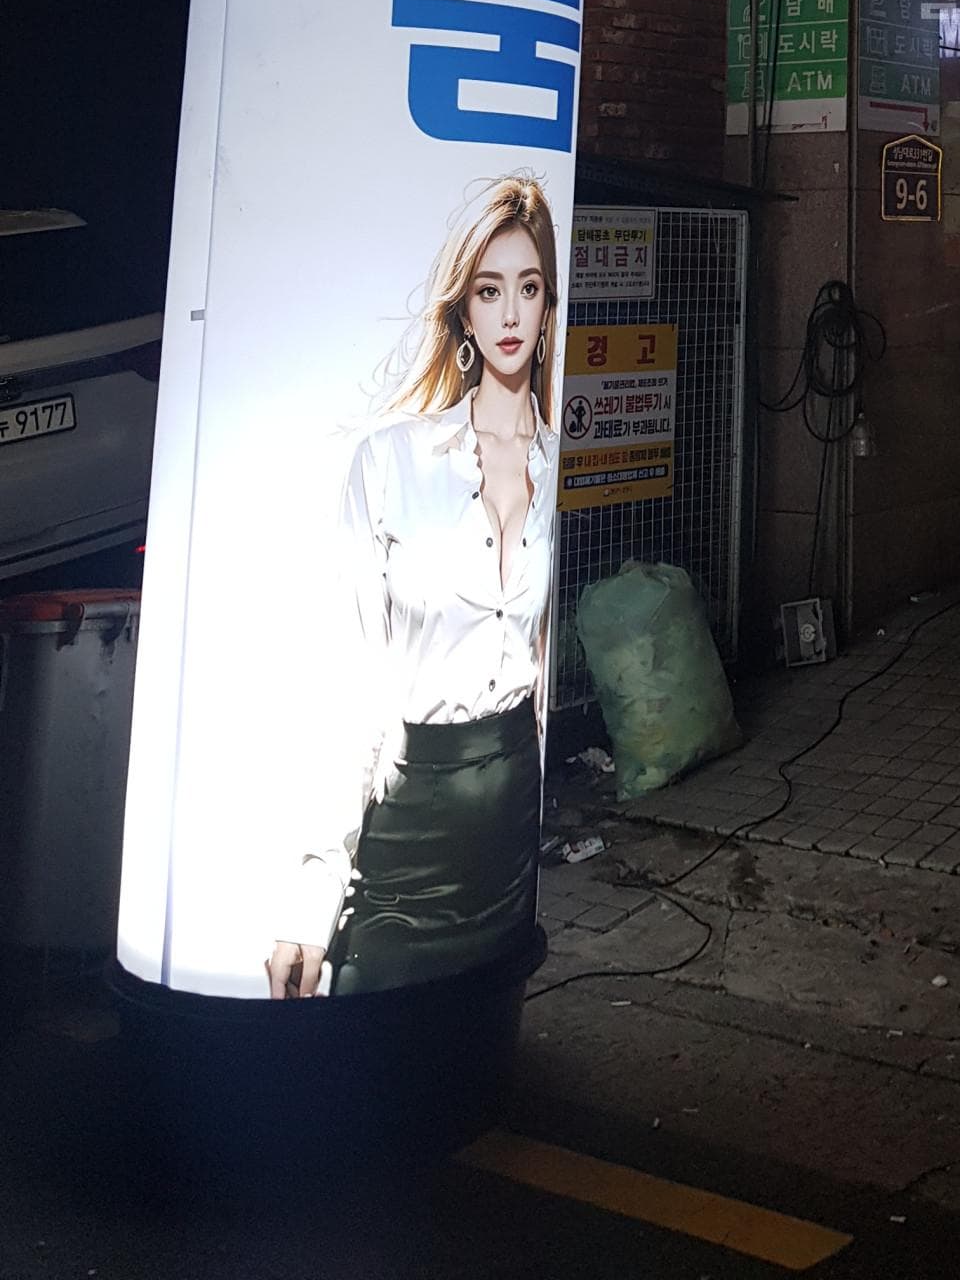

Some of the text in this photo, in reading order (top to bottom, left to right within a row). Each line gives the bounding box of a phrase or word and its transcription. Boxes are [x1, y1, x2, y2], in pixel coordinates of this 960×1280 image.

[777, 29, 838, 55] 도시락
[786, 70, 833, 93] ATM
[901, 73, 932, 97] ATM
[896, 178, 928, 210] 9-6
[614, 229, 647, 242] 무단투기
[574, 245, 648, 268] 절대금지
[587, 334, 656, 367] 경고
[594, 392, 671, 415] 쓰레기 불법투기 시
[16, 402, 67, 435] 9177
[593, 419, 631, 439] 과태료가
